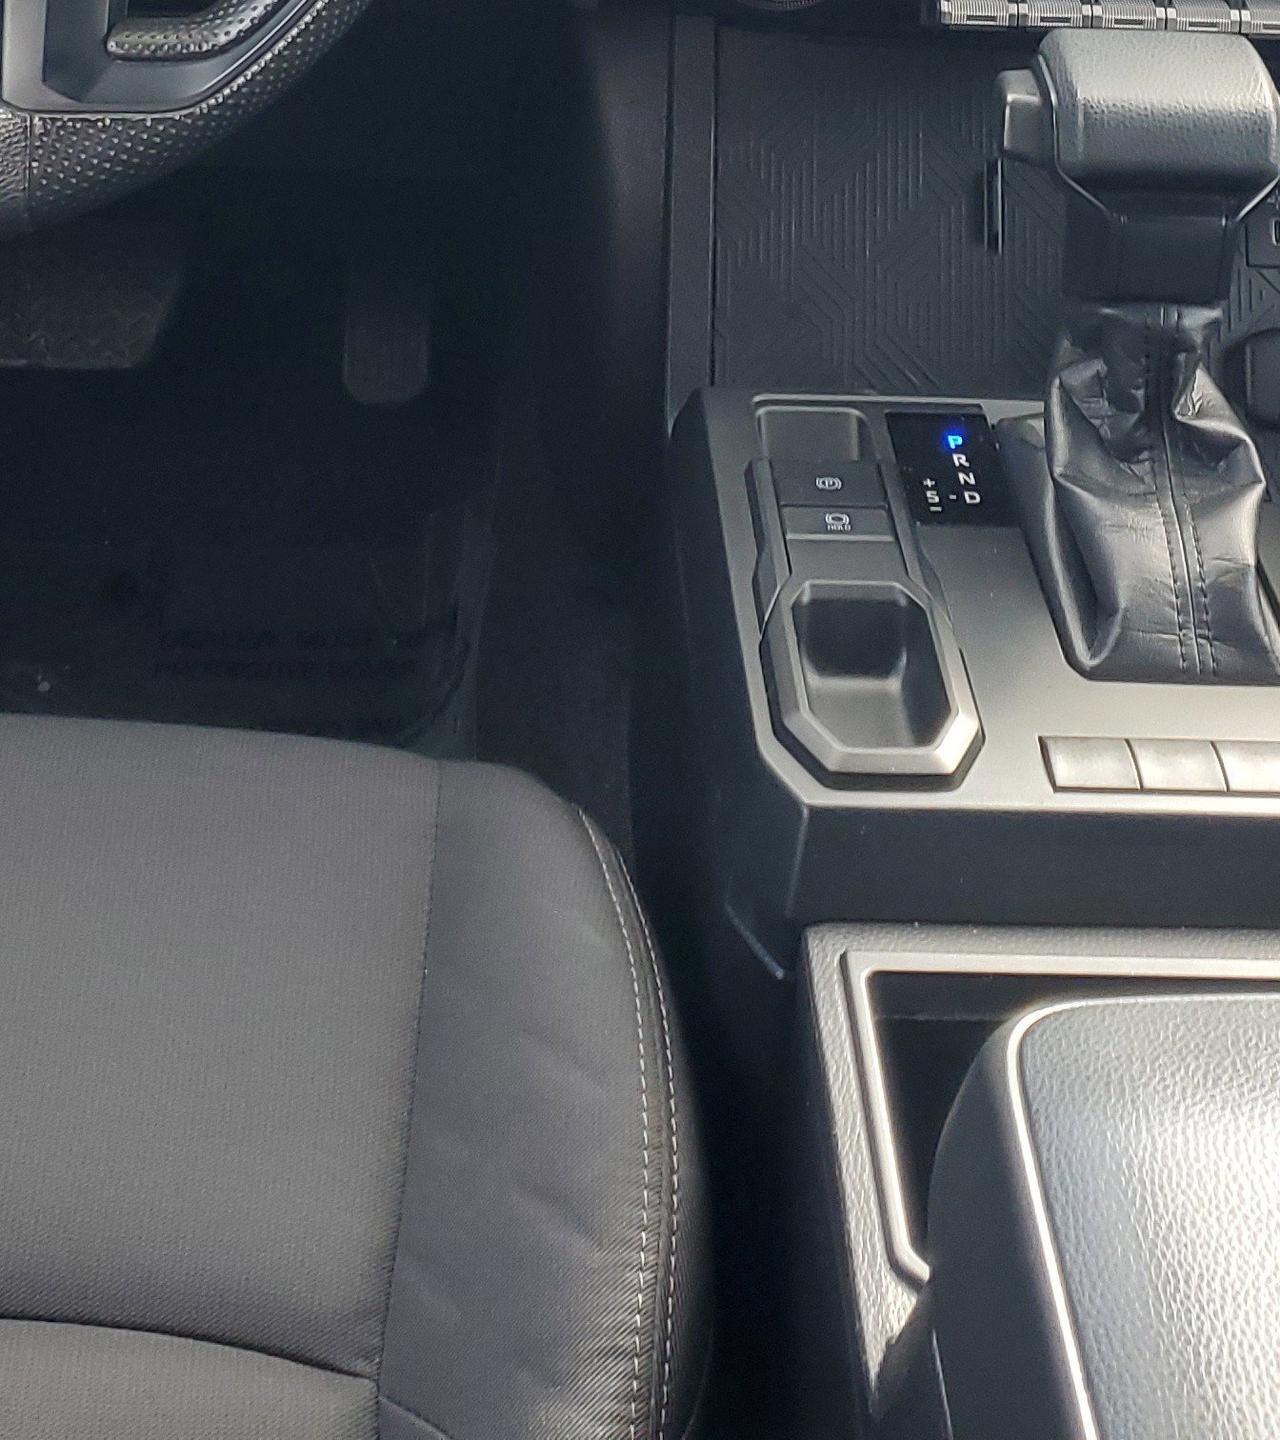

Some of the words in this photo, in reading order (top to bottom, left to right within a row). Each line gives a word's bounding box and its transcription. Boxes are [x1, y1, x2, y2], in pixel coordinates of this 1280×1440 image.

[947, 434, 963, 449] P
[952, 453, 970, 467] R
[958, 472, 976, 486] N
[926, 490, 940, 503] S
[964, 490, 981, 504] D
